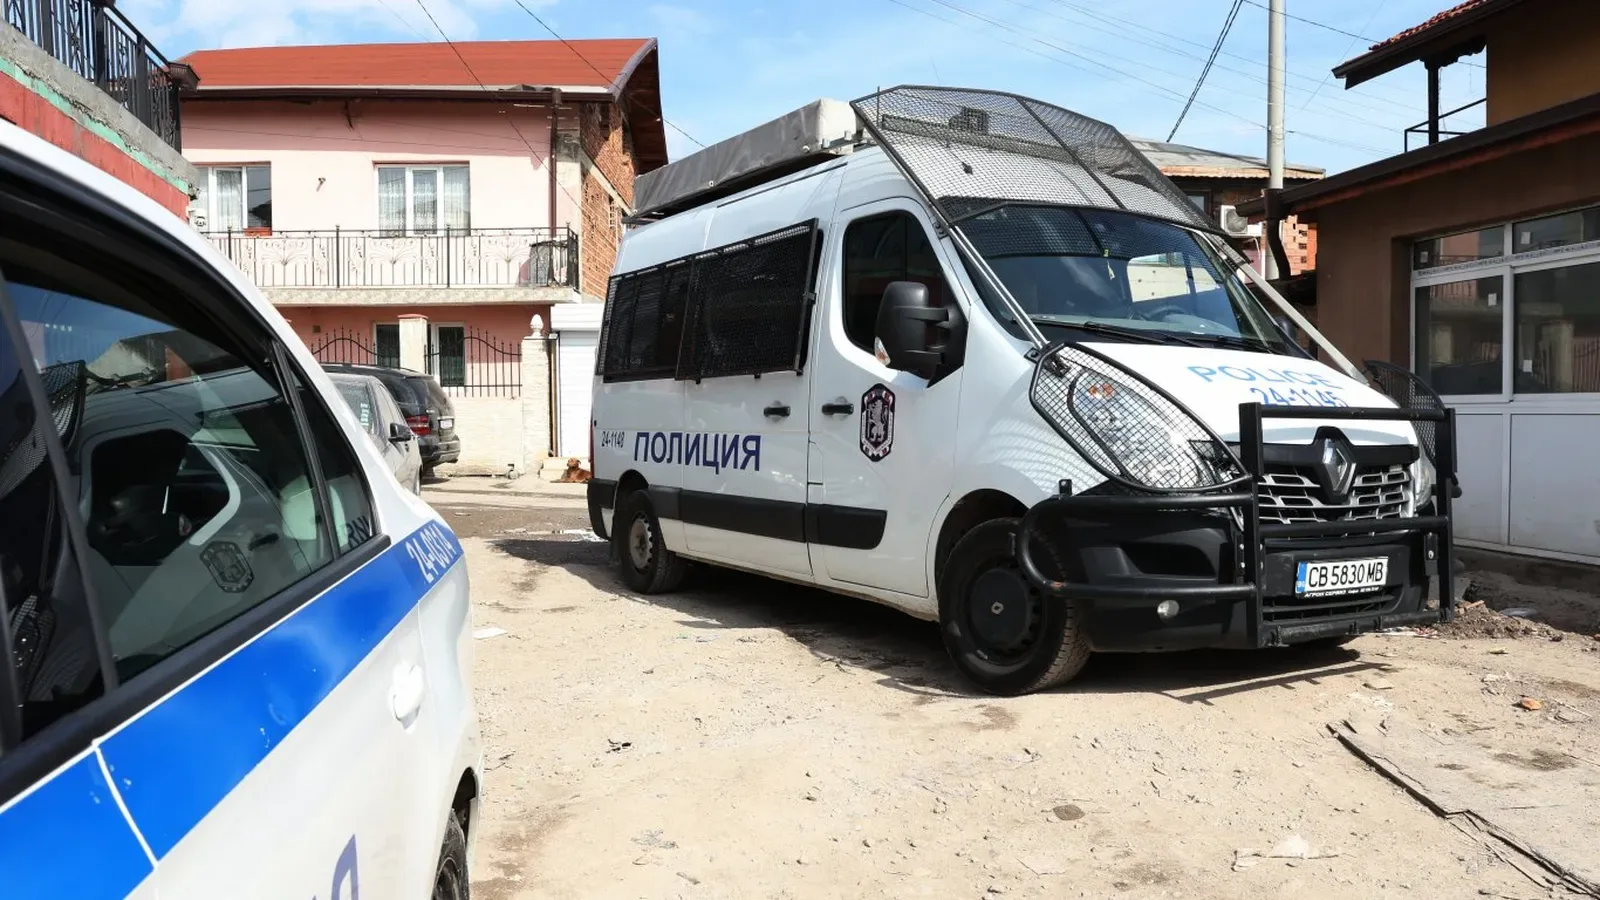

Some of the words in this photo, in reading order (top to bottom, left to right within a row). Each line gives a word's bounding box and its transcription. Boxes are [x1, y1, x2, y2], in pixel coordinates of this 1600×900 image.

[1187, 365, 1343, 390] POLICE
[634, 431, 761, 474] ПОЛИЦИЯ
[405, 523, 457, 583] 24-0314
